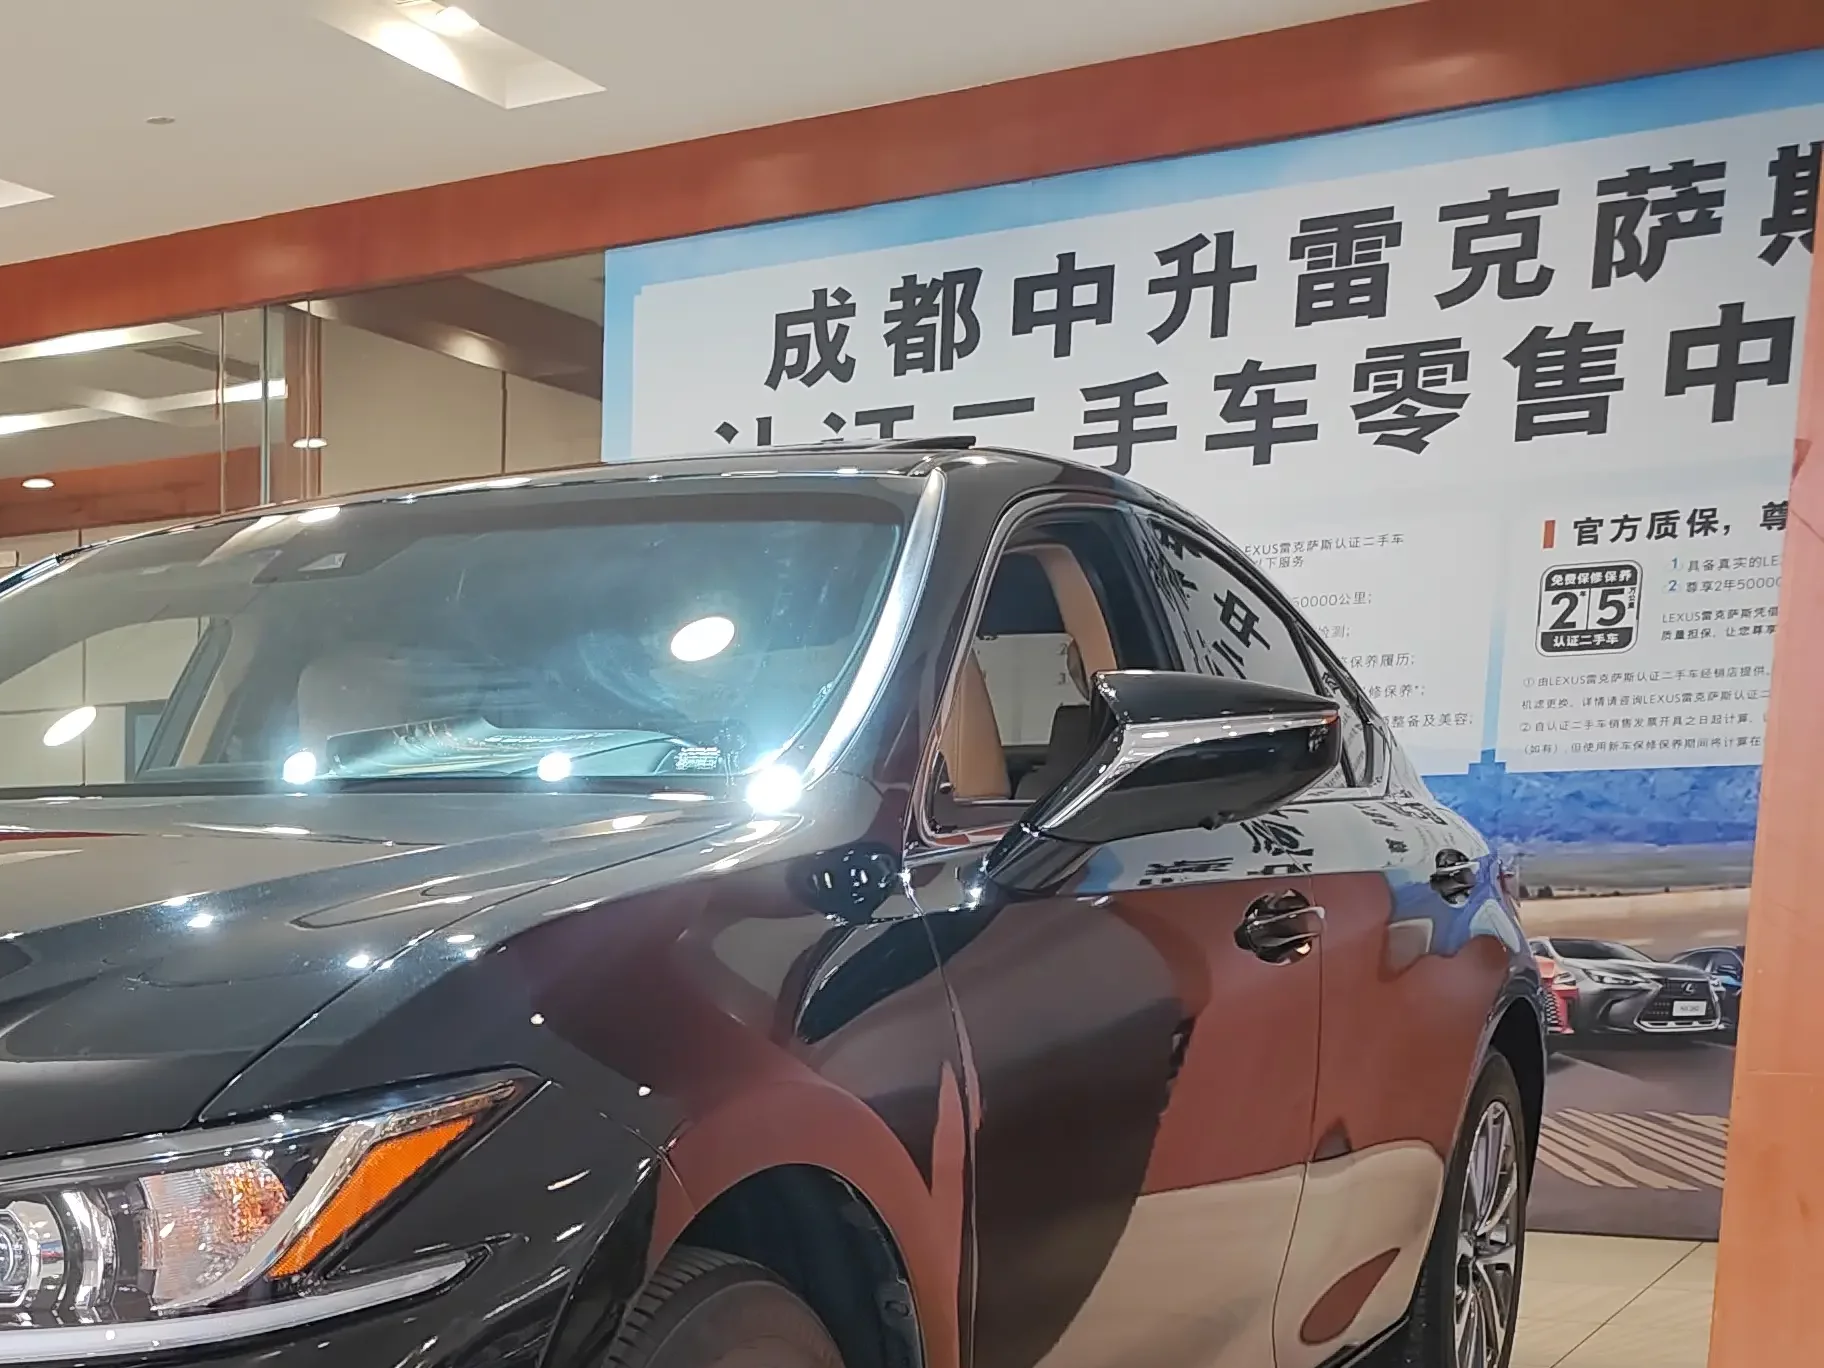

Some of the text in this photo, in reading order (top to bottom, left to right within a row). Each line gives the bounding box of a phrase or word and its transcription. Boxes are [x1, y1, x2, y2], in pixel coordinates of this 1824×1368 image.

[1671, 557, 1679, 569] 1
[1551, 569, 1632, 587] 免费保修保养
[1668, 579, 1678, 592] 2
[1549, 591, 1578, 630] 2
[1596, 587, 1626, 626] 5
[1553, 633, 1619, 648] 认证二手车
